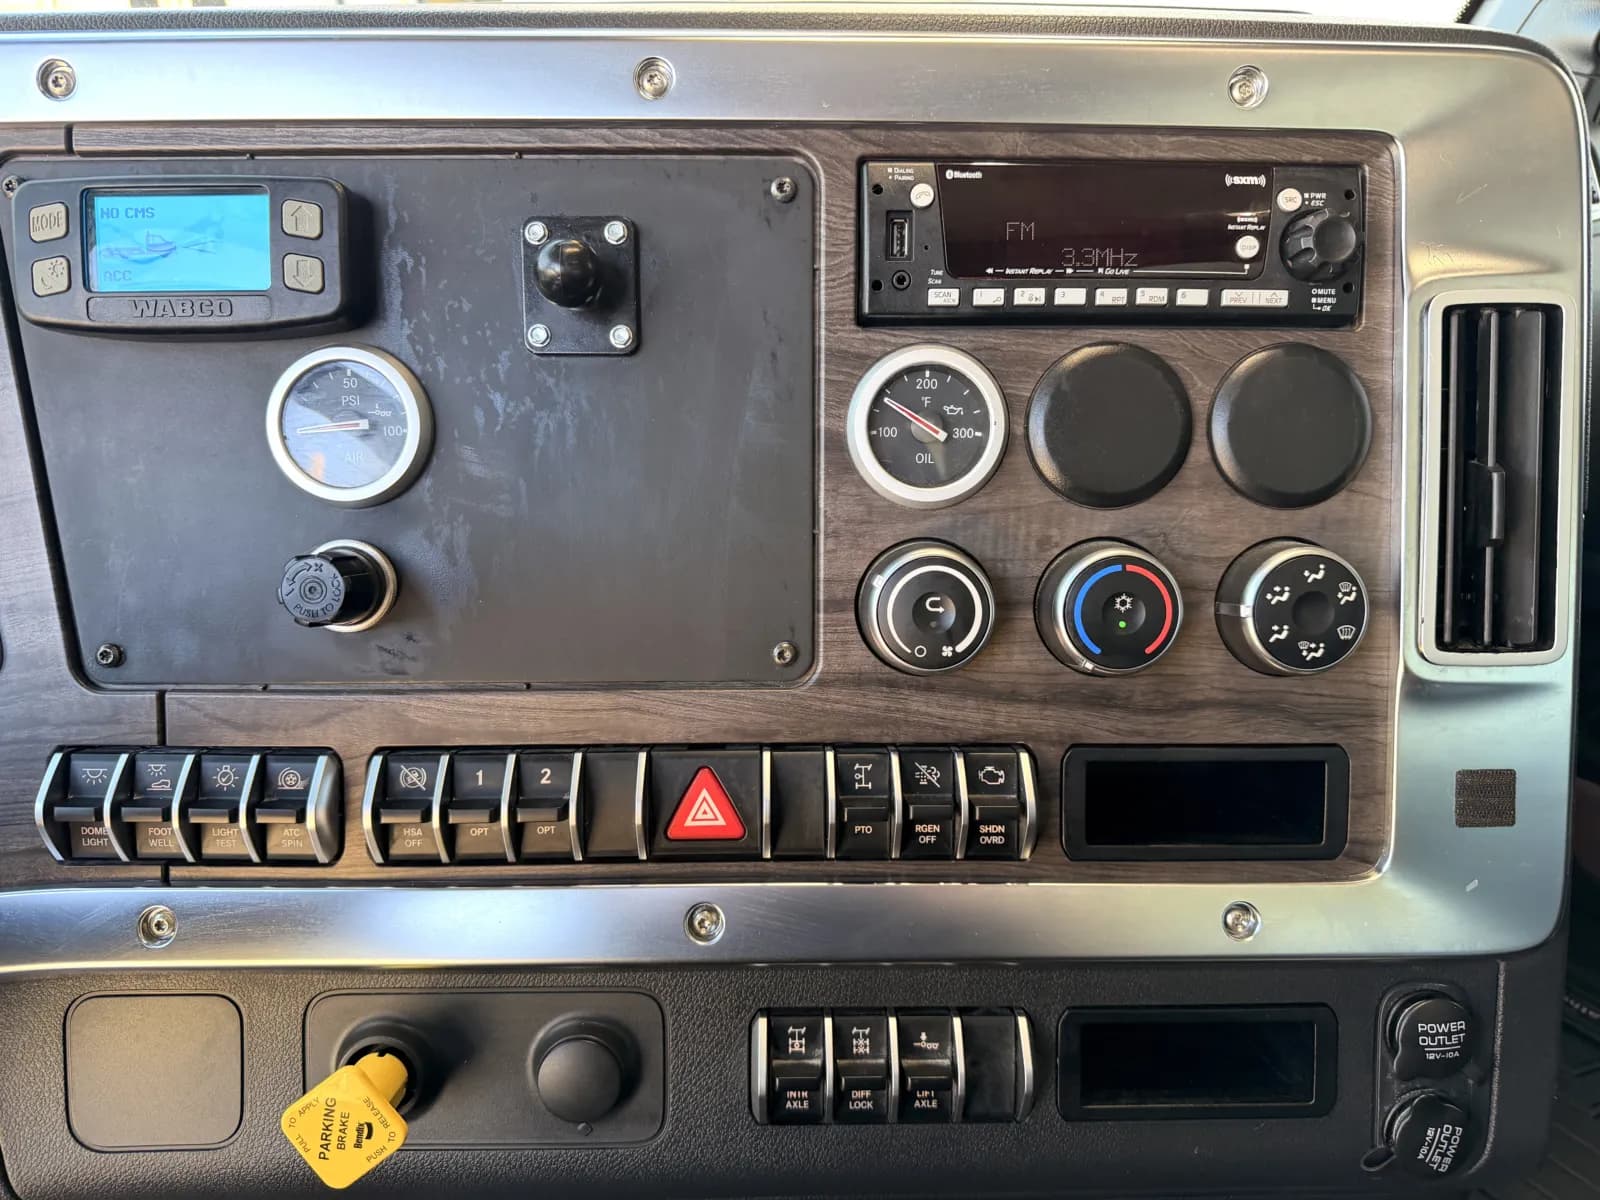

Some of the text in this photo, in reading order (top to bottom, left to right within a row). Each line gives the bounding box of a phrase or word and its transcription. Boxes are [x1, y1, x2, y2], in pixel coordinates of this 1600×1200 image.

[953, 171, 983, 179] Bluetooth
[101, 206, 155, 219] NO CMS
[32, 210, 63, 233] MODE
[1006, 222, 1035, 240] FM
[1062, 248, 1138, 267] 3.3MHz
[1148, 295, 1165, 303] RDM
[131, 298, 234, 318] WABCO
[343, 377, 358, 388] 50
[916, 379, 938, 390] 200
[341, 396, 360, 406] PSI
[383, 425, 403, 437] 100
[877, 426, 898, 438] 100
[952, 427, 974, 439] 300
[915, 453, 935, 464] OIL
[293, 603, 319, 618] PUSH
[320, 602, 334, 616] TO
[475, 769, 483, 786] 1
[540, 768, 551, 785] 2
[81, 826, 109, 836] DOME
[148, 827, 172, 837] FOOT
[212, 828, 239, 838] LIGHT
[283, 828, 300, 838] ATC
[403, 827, 423, 837] HSA
[470, 827, 488, 837] OPT
[536, 825, 555, 835] OPT
[854, 825, 873, 834] PTO
[915, 824, 940, 833] RGEN
[979, 824, 1005, 834] SHDN
[82, 837, 108, 847] LIGHT
[149, 838, 174, 848] WELL
[215, 839, 237, 849] TEST
[281, 839, 303, 849] SPIN
[404, 839, 423, 848] OFF
[918, 835, 937, 844] OFF
[979, 836, 1005, 845] OVRD
[1418, 1021, 1466, 1033] POWER
[1418, 1034, 1466, 1046] OUTLET
[851, 1090, 871, 1099] DIFF
[785, 1101, 809, 1109] AXLE
[849, 1101, 874, 1110] LOCK
[914, 1100, 938, 1109] AXLE
[288, 1096, 321, 1153] PULL TO APPLY
[318, 1097, 336, 1161] PARKING
[362, 1096, 397, 1163] PUSH TO RELEASE
[336, 1112, 350, 1150] BRAKE
[353, 1121, 365, 1149] Bendix
[1429, 1124, 1452, 1170] OUTLET
[1438, 1126, 1463, 1173] POWER
